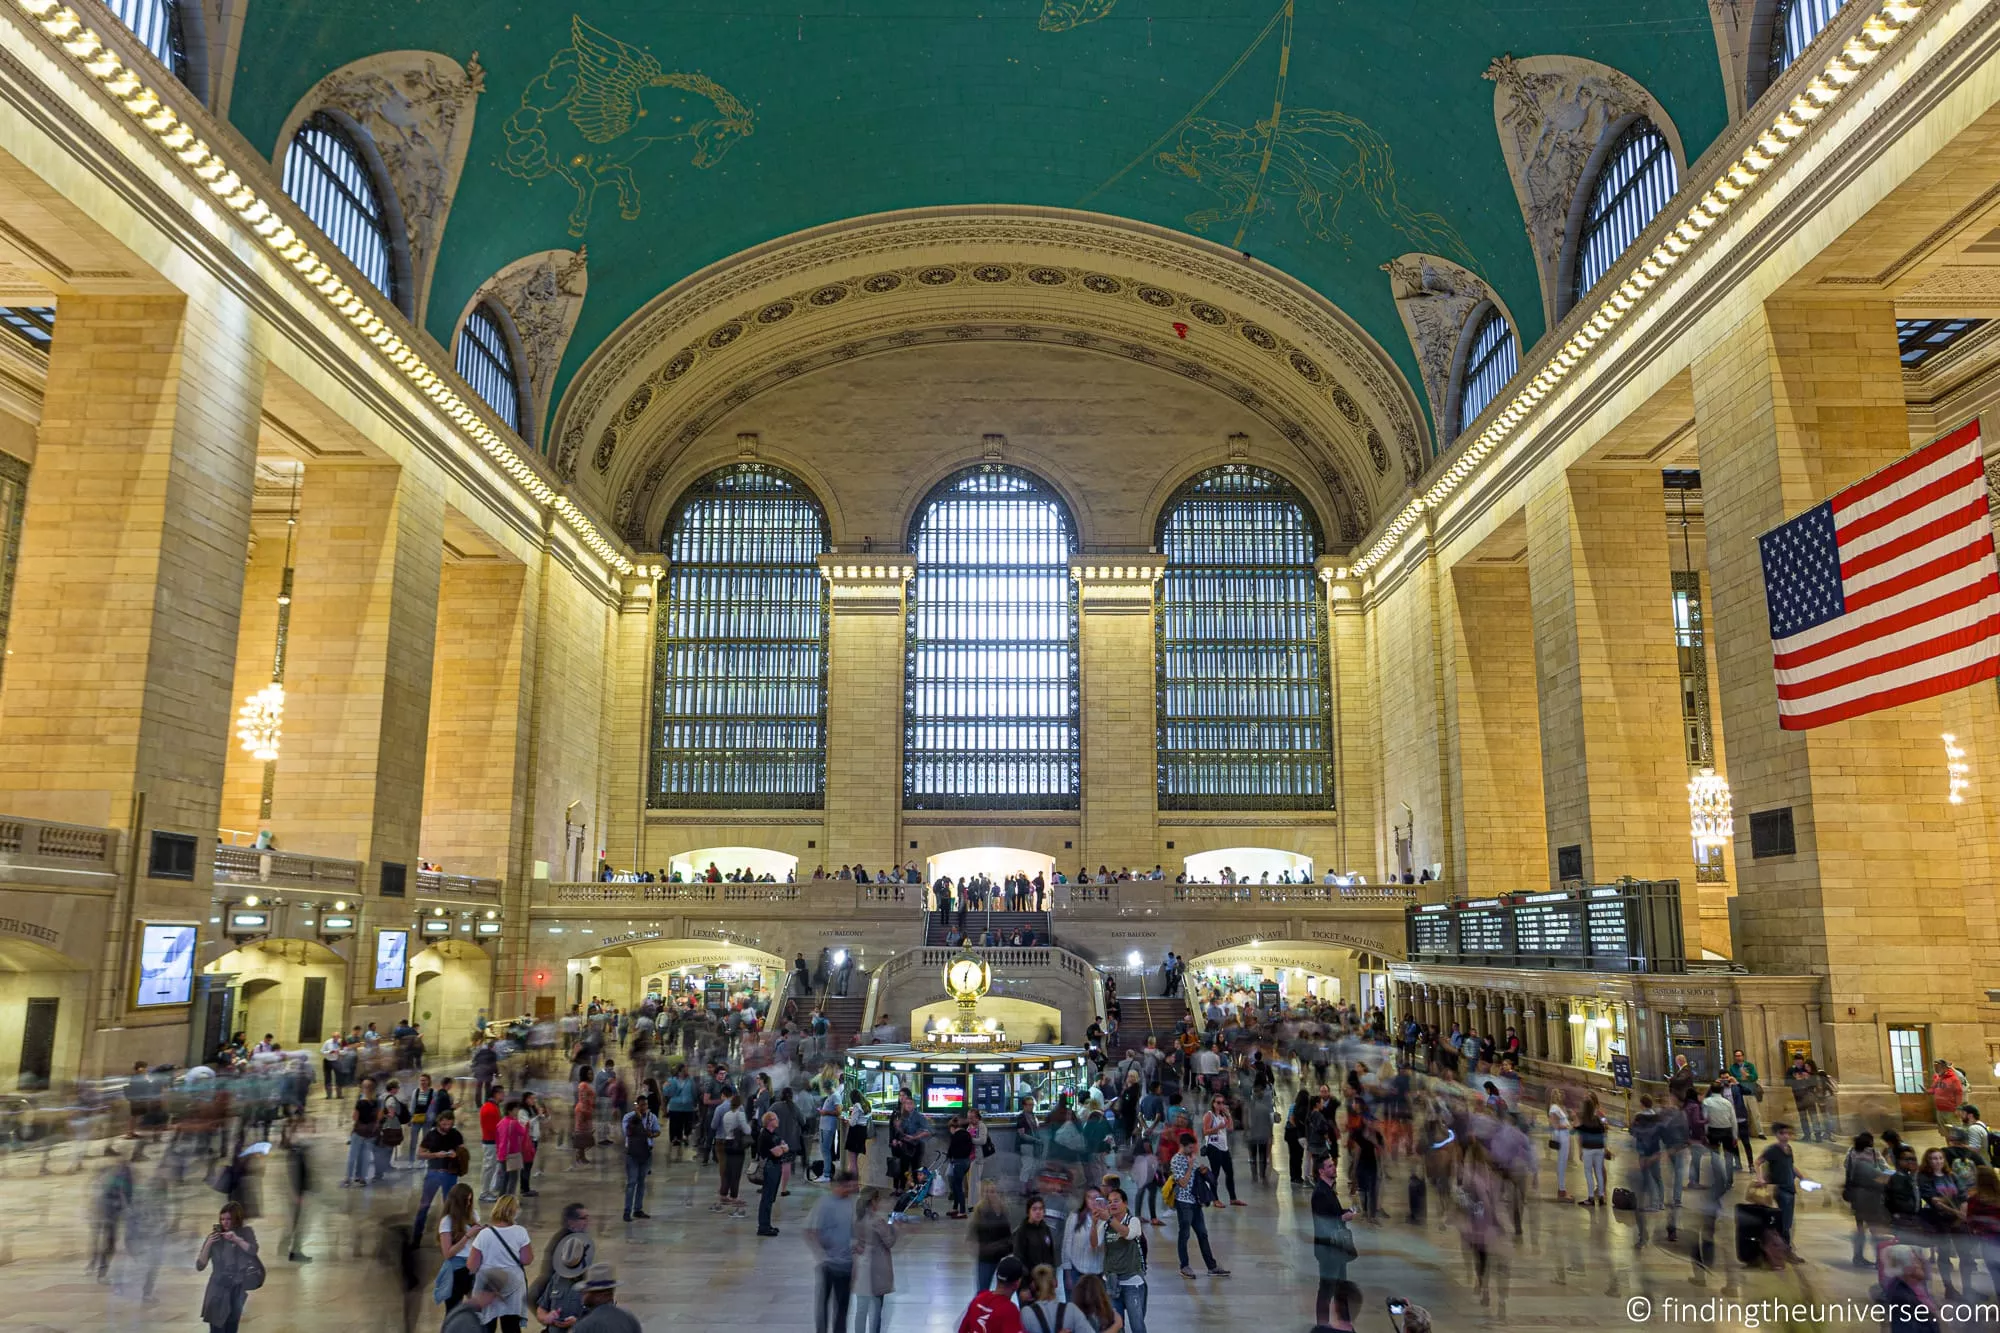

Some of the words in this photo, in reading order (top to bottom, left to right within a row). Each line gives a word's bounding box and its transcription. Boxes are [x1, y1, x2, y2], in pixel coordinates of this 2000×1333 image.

[21, 921, 59, 942] STREET
[693, 929, 742, 942] LEXINGTON
[602, 932, 634, 945] TRACKS
[1217, 932, 1265, 948] LEXINGTON
[1267, 930, 1283, 939] AVE
[1312, 930, 1341, 940] TICKET
[1342, 934, 1385, 949] MACHINES
[1260, 956, 1290, 965] SUBWAY
[1686, 987, 1715, 996] SERVICE
